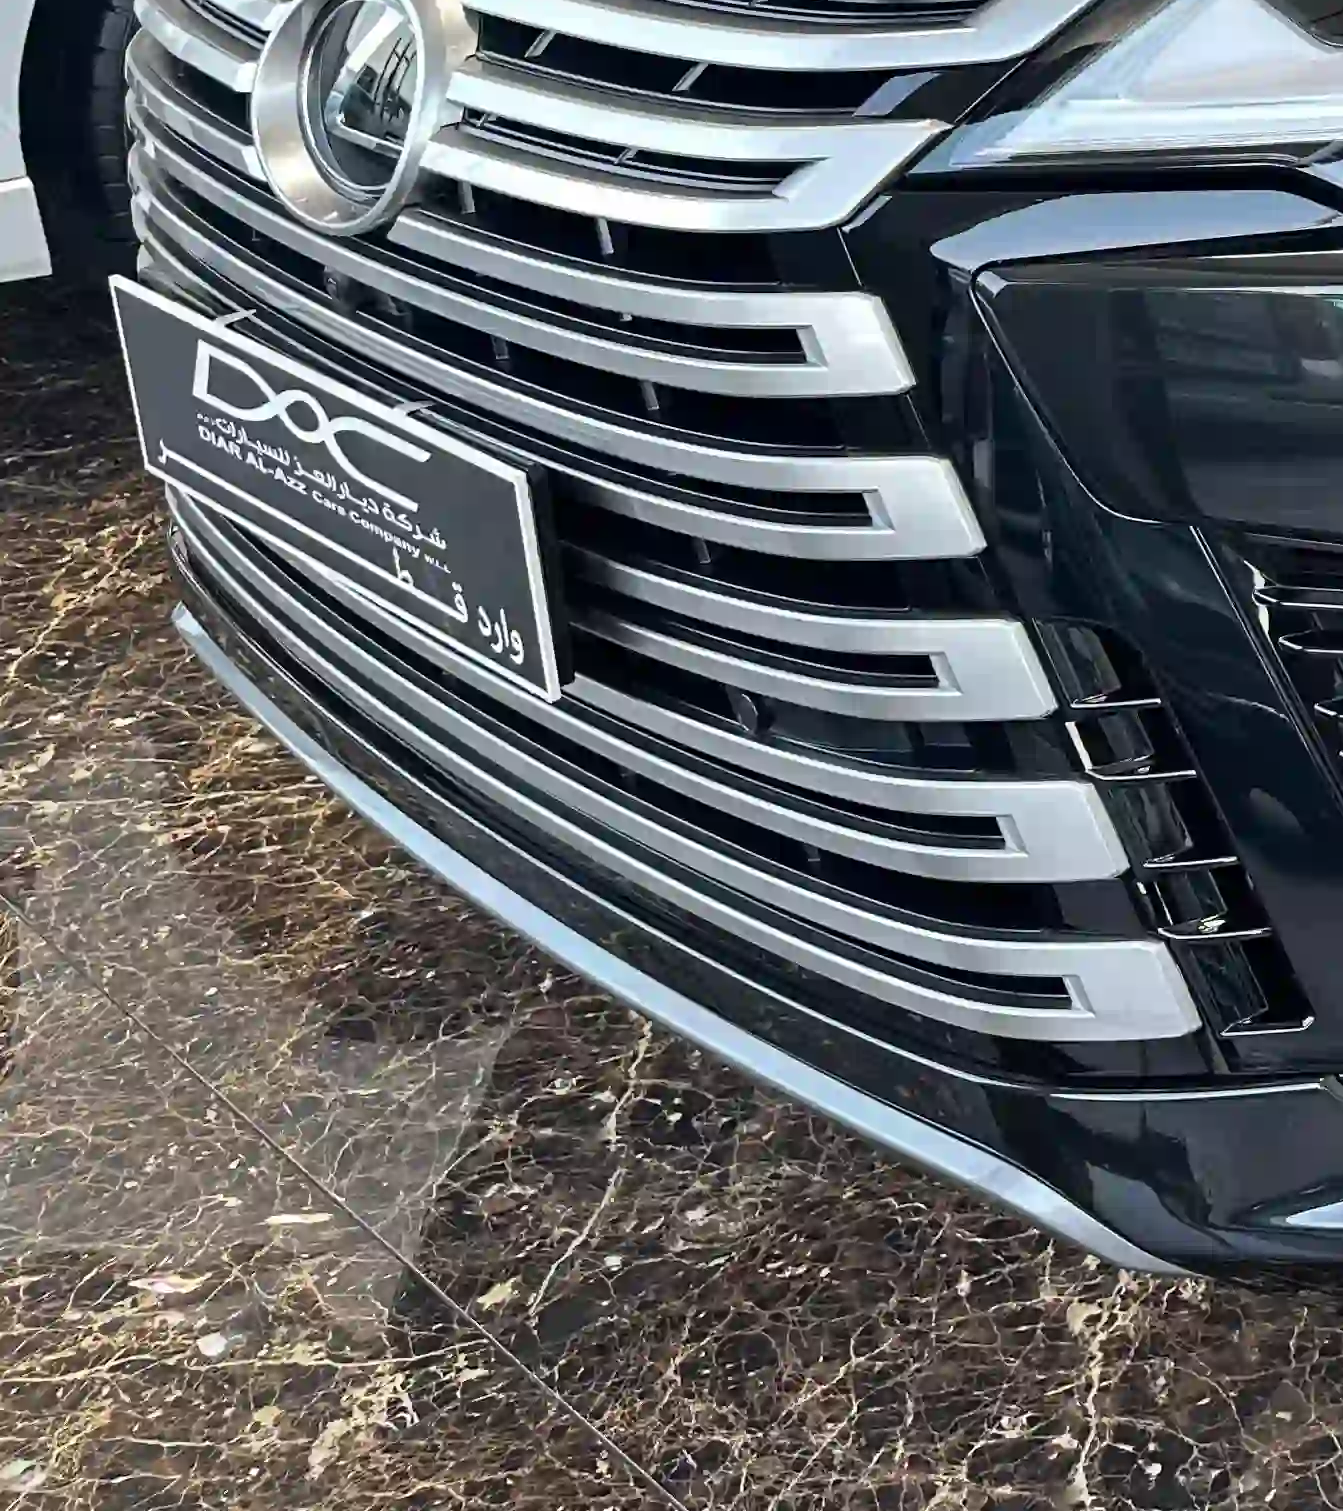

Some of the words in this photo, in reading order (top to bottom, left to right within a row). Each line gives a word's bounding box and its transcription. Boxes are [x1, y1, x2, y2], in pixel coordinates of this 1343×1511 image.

[197, 425, 243, 461] DIAR
[311, 489, 347, 517] Cars
[348, 509, 421, 559] Company
[478, 605, 525, 665] وارد
